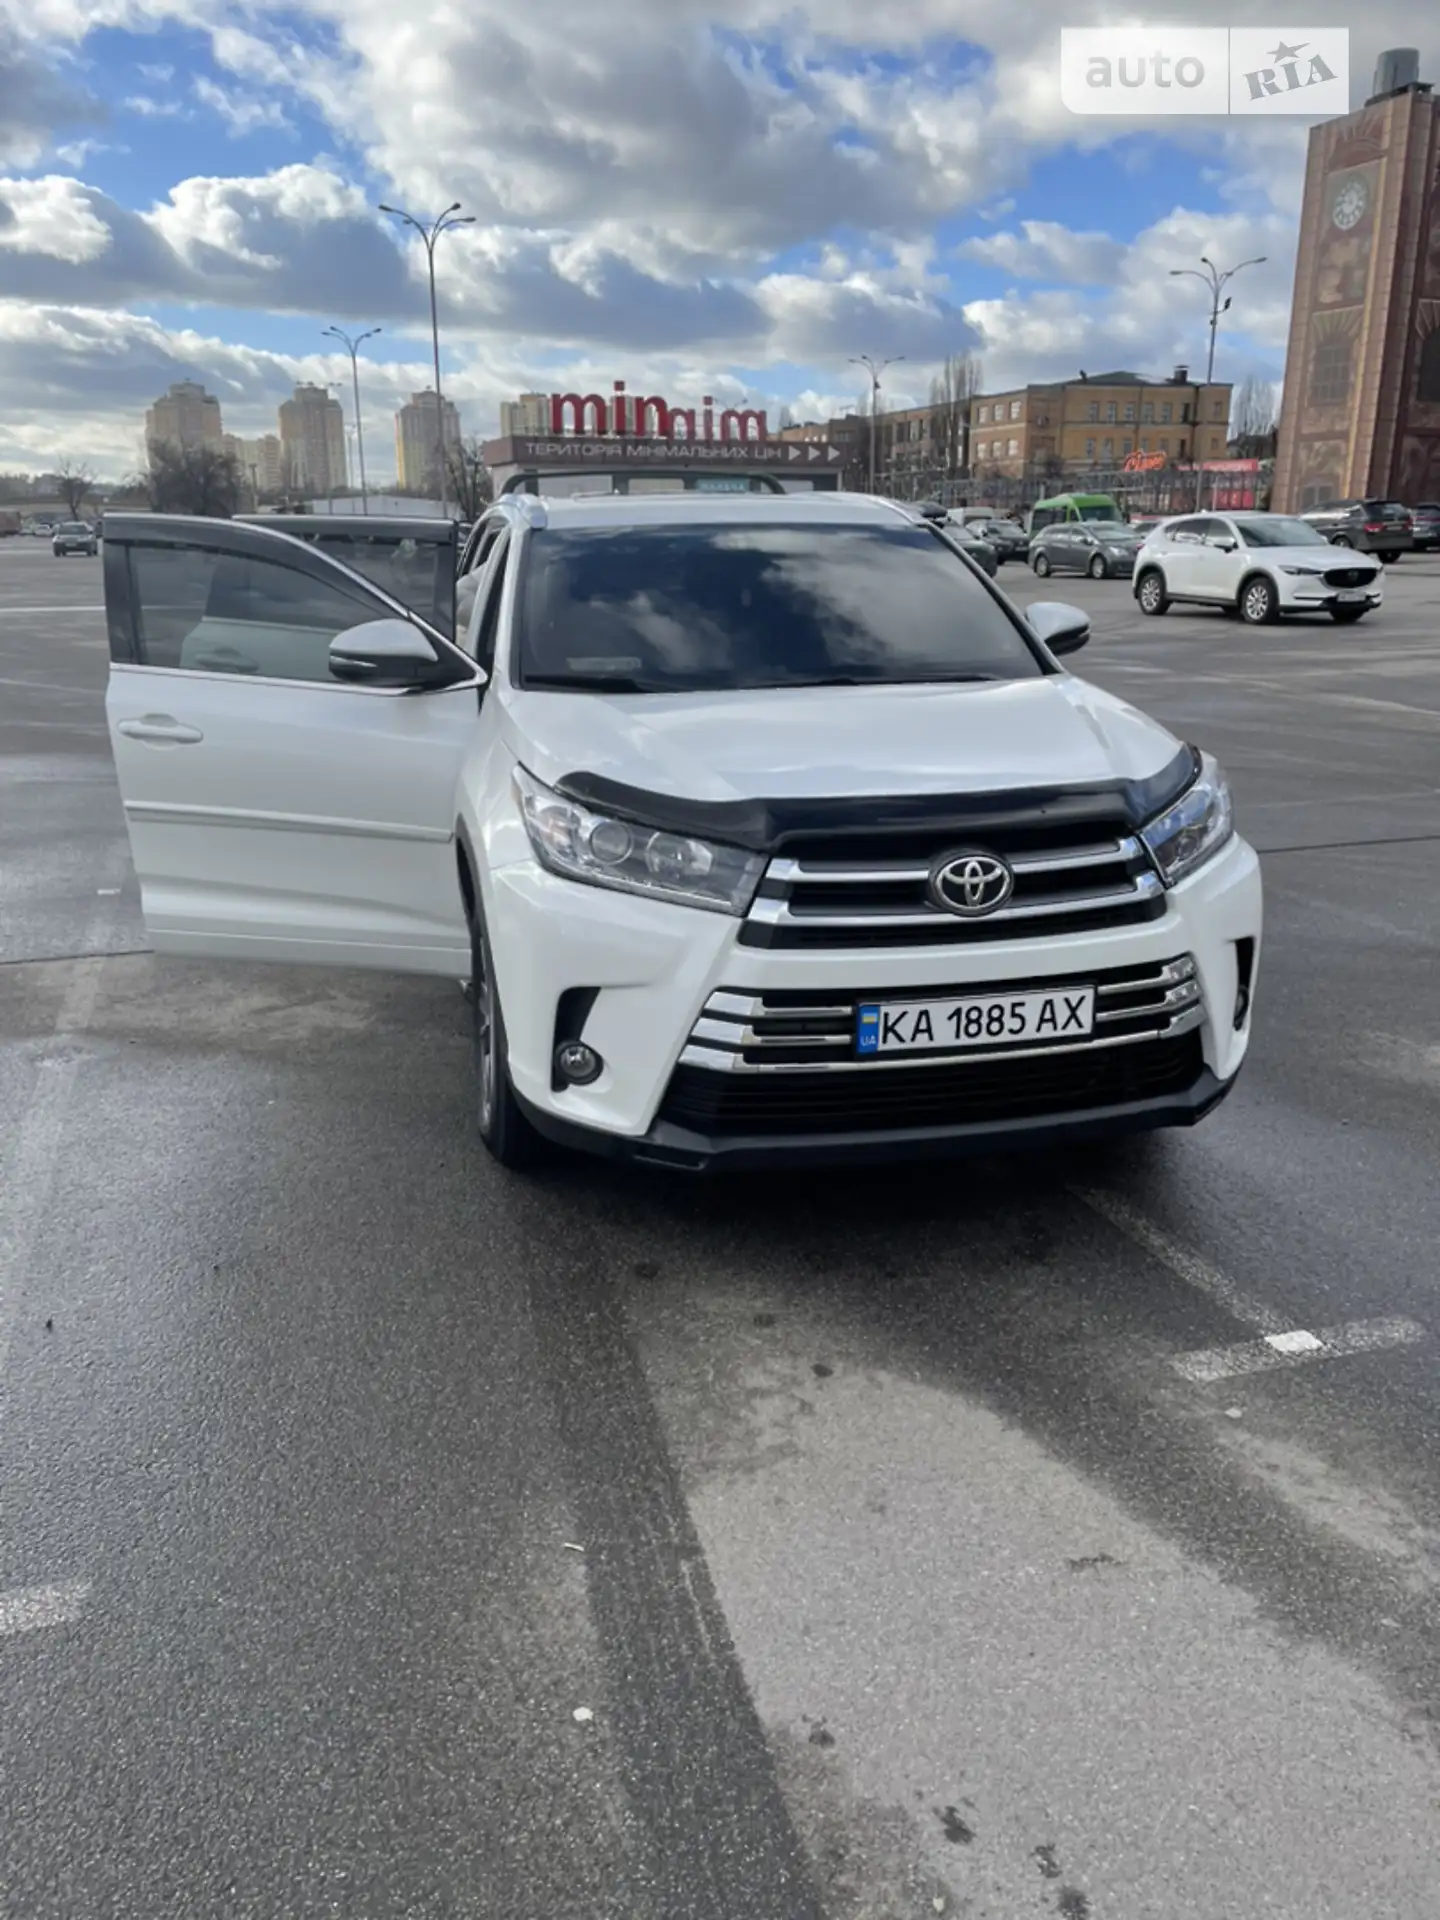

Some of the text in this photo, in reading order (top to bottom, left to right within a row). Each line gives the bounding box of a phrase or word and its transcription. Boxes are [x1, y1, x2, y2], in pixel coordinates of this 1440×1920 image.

[525, 442, 622, 457] ТЕРИТОРІЯ
[626, 443, 748, 459] МІНІМАЛЬНИХ
[882, 995, 1087, 1045] KA 1885 AX
[860, 1035, 877, 1047] UA
